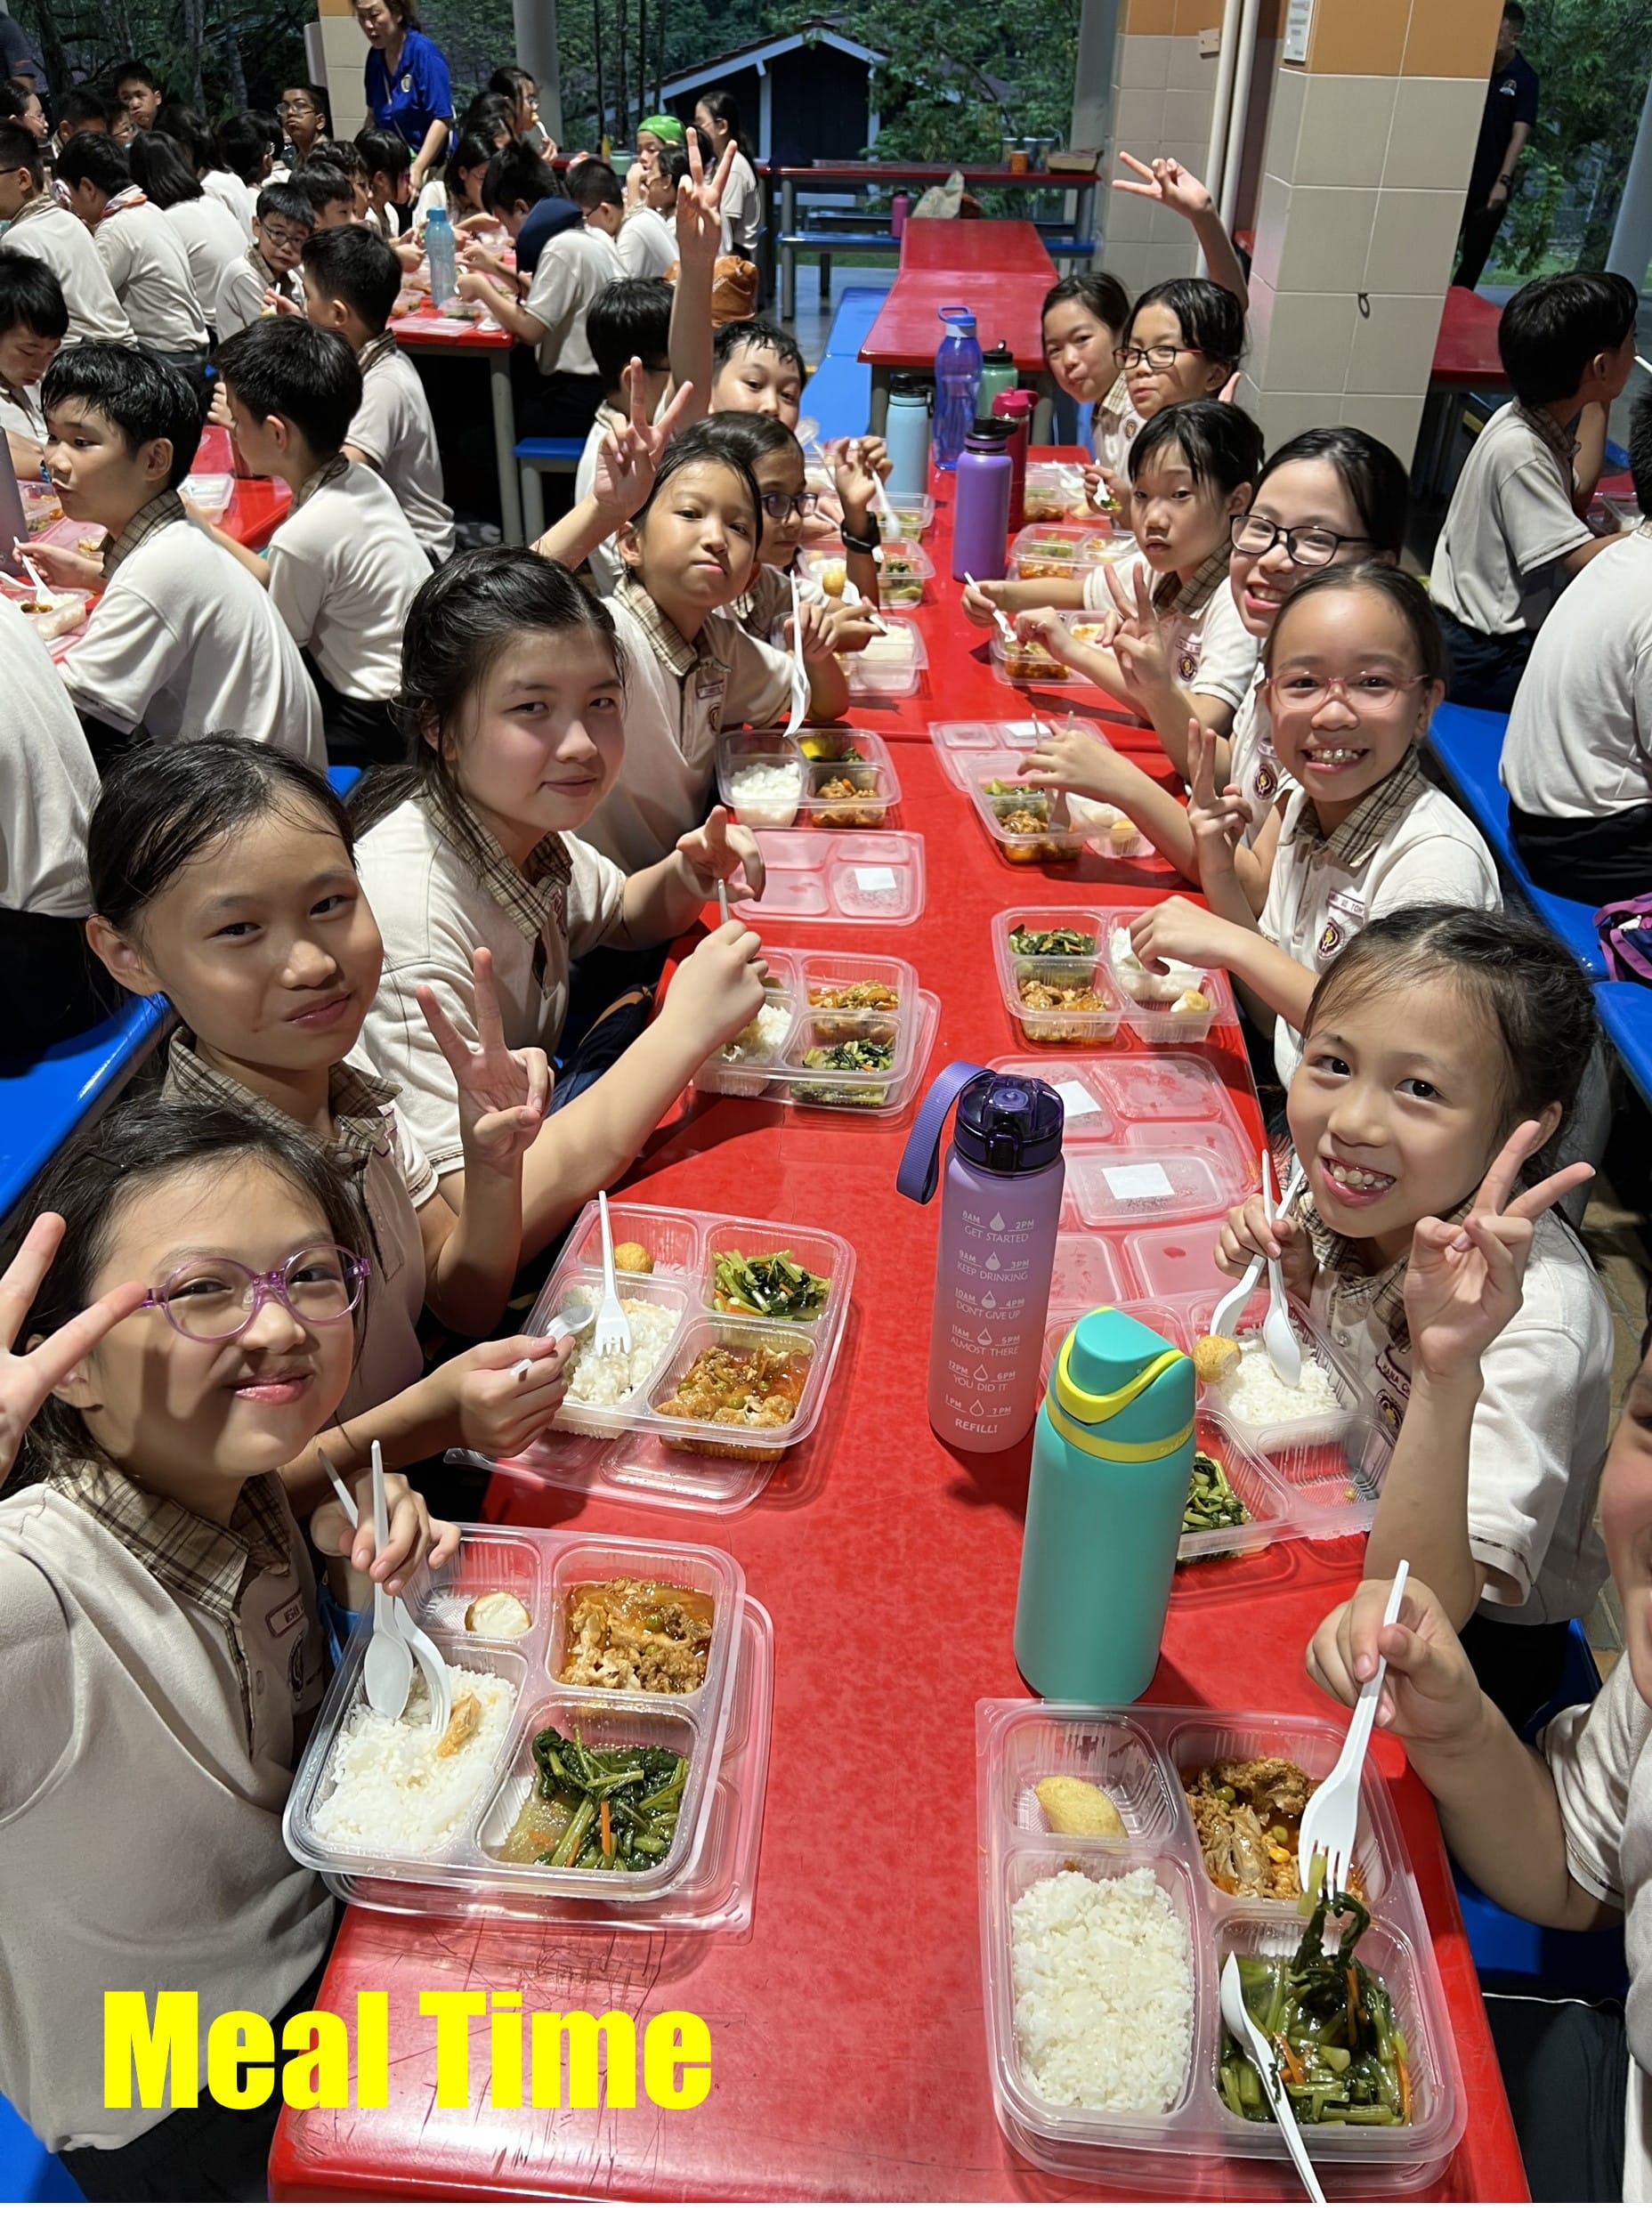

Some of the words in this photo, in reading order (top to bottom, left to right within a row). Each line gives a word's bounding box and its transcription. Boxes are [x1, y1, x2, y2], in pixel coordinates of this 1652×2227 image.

[962, 1210, 981, 1224] 8AM
[1016, 1219, 1034, 1229] 2PM
[964, 1225, 984, 1239] GET
[985, 1232, 1029, 1243] STARTED
[959, 1249, 976, 1263] 9AM
[957, 1260, 977, 1275] KEEP
[979, 1270, 1029, 1282] DRINKING
[1010, 1259, 1030, 1269] 3PM
[955, 1287, 976, 1303] 10AM
[1006, 1297, 1025, 1308] 4PM
[984, 1310, 1008, 1320] GIVE
[1008, 1309, 1021, 1320] UP
[952, 1324, 969, 1338] 11AM
[950, 1337, 987, 1356] ALMOST
[989, 1346, 1019, 1356] THERE
[1001, 1334, 1021, 1345] 5PM
[949, 1359, 968, 1375] 12PM
[997, 1370, 1016, 1381] 6PM
[953, 1374, 974, 1389] YOU
[976, 1381, 996, 1392] DID
[998, 1382, 1008, 1392] IT
[955, 1417, 998, 1434] REFILL!
